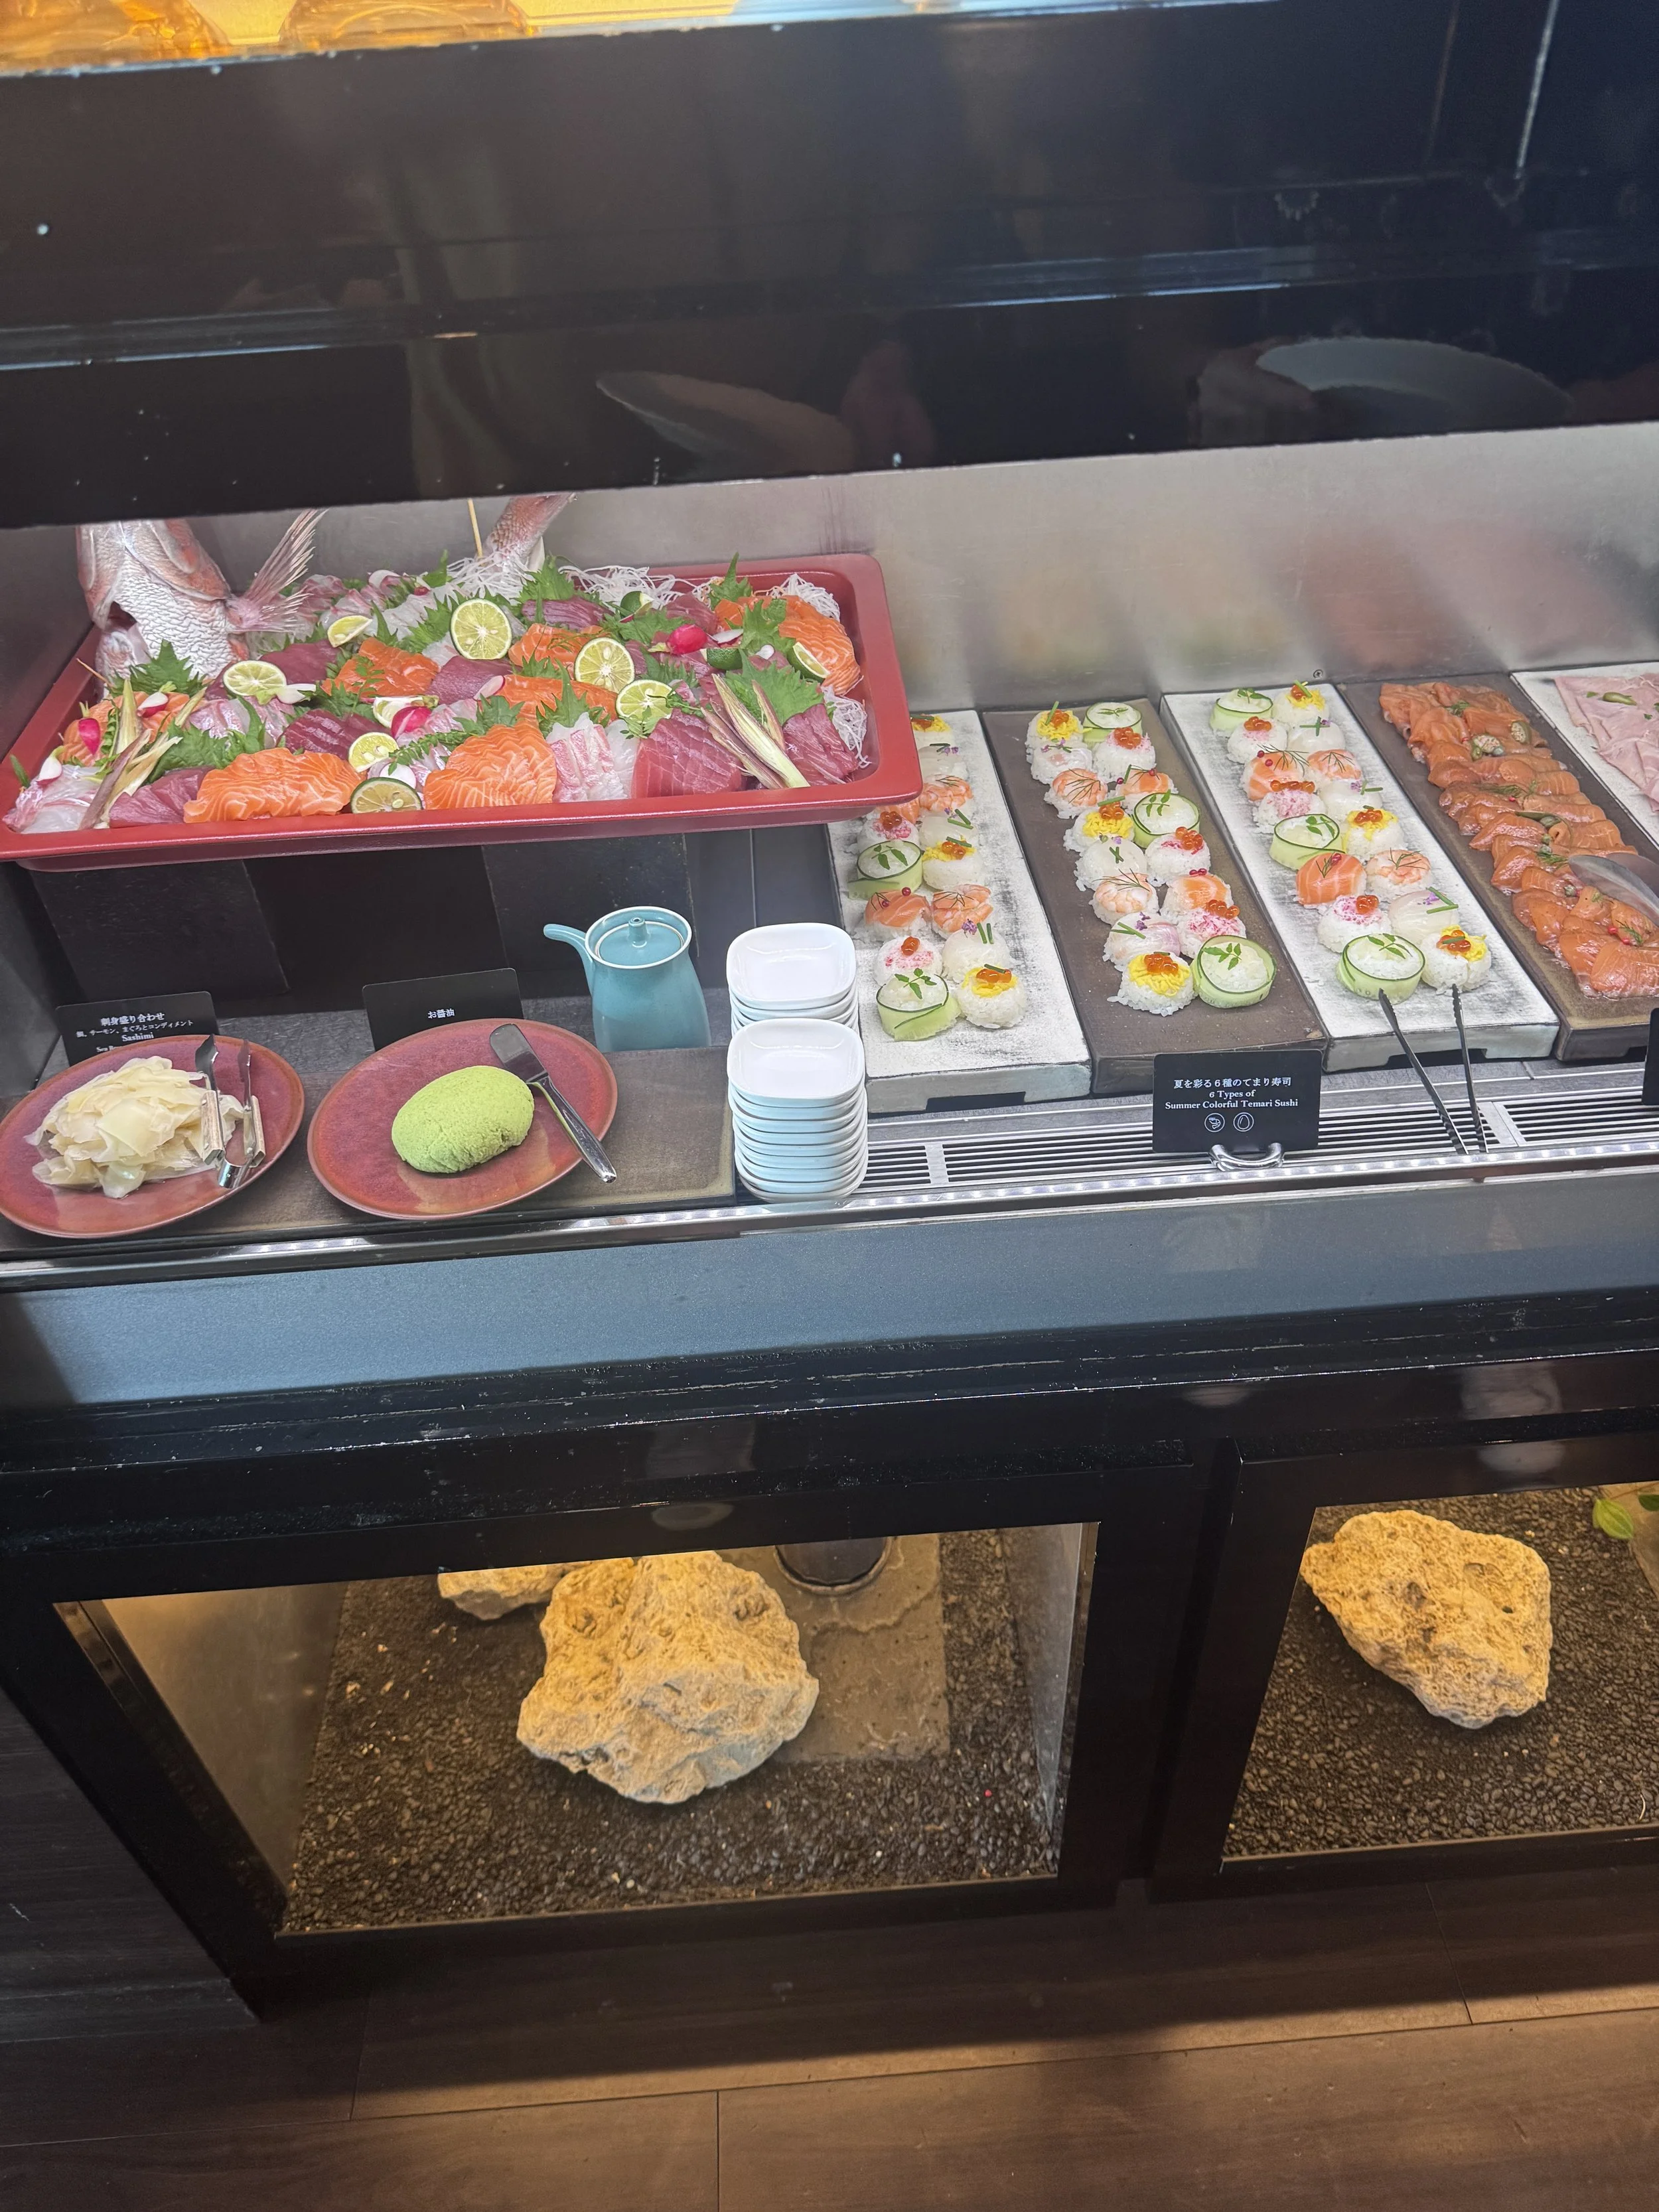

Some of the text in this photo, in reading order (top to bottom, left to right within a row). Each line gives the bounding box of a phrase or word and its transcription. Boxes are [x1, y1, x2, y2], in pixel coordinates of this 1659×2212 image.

[100, 1013, 165, 1027] 刺身盛り合わせ
[121, 1032, 154, 1042] Sashimi
[1217, 1090, 1243, 1100] Types
[1202, 1100, 1238, 1109] Colorful
[1241, 1099, 1273, 1108] Temari
[1275, 1098, 1299, 1107] Sushi
